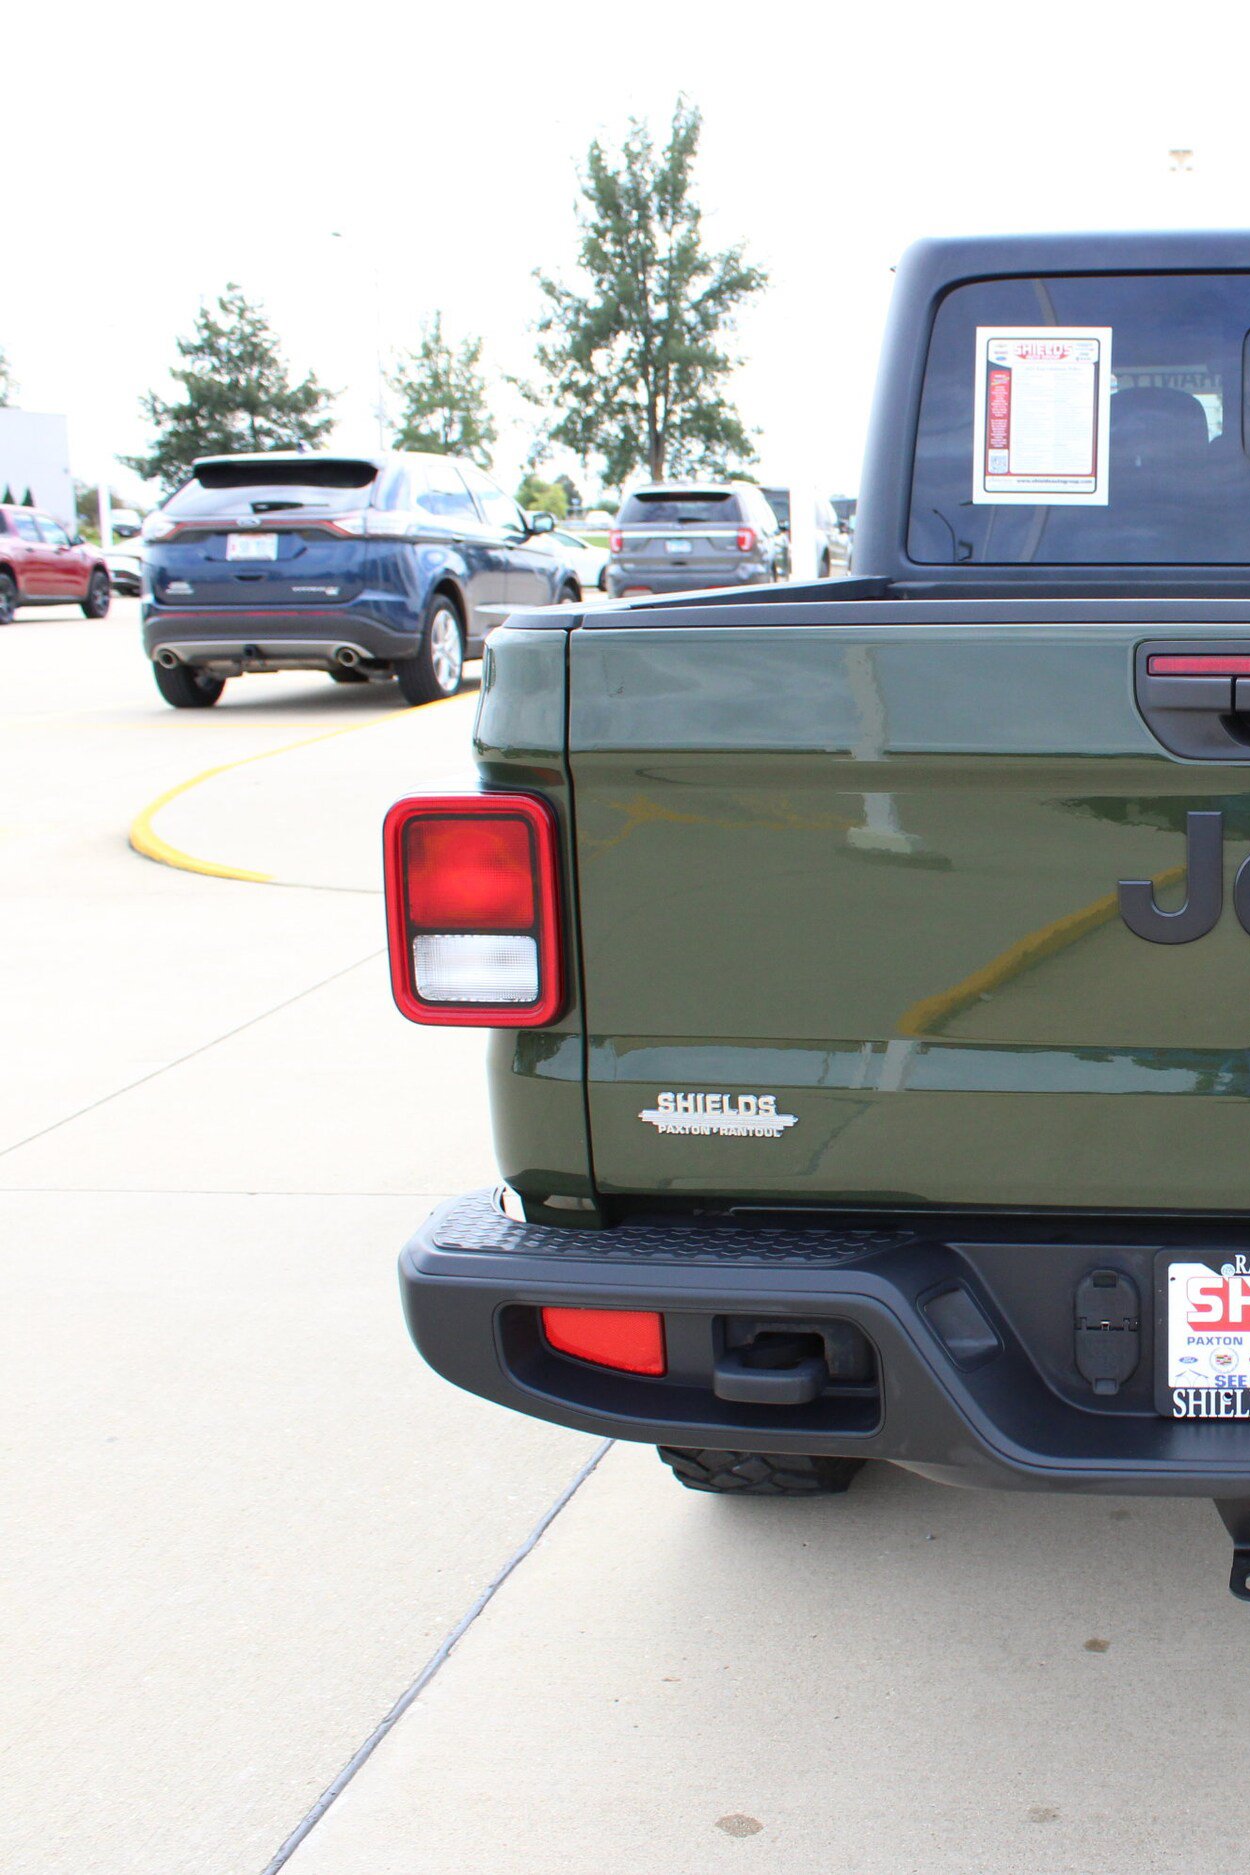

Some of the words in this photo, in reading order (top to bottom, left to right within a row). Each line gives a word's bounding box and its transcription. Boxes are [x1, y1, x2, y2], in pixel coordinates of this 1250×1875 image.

[1015, 343, 1073, 356] SHIELDS
[657, 1091, 777, 1116] SHIELDS
[658, 1124, 711, 1136] PAXTON
[719, 1126, 784, 1138] RANTOUL
[1187, 1336, 1243, 1346] PAXTON
[1215, 1374, 1248, 1388] SEE
